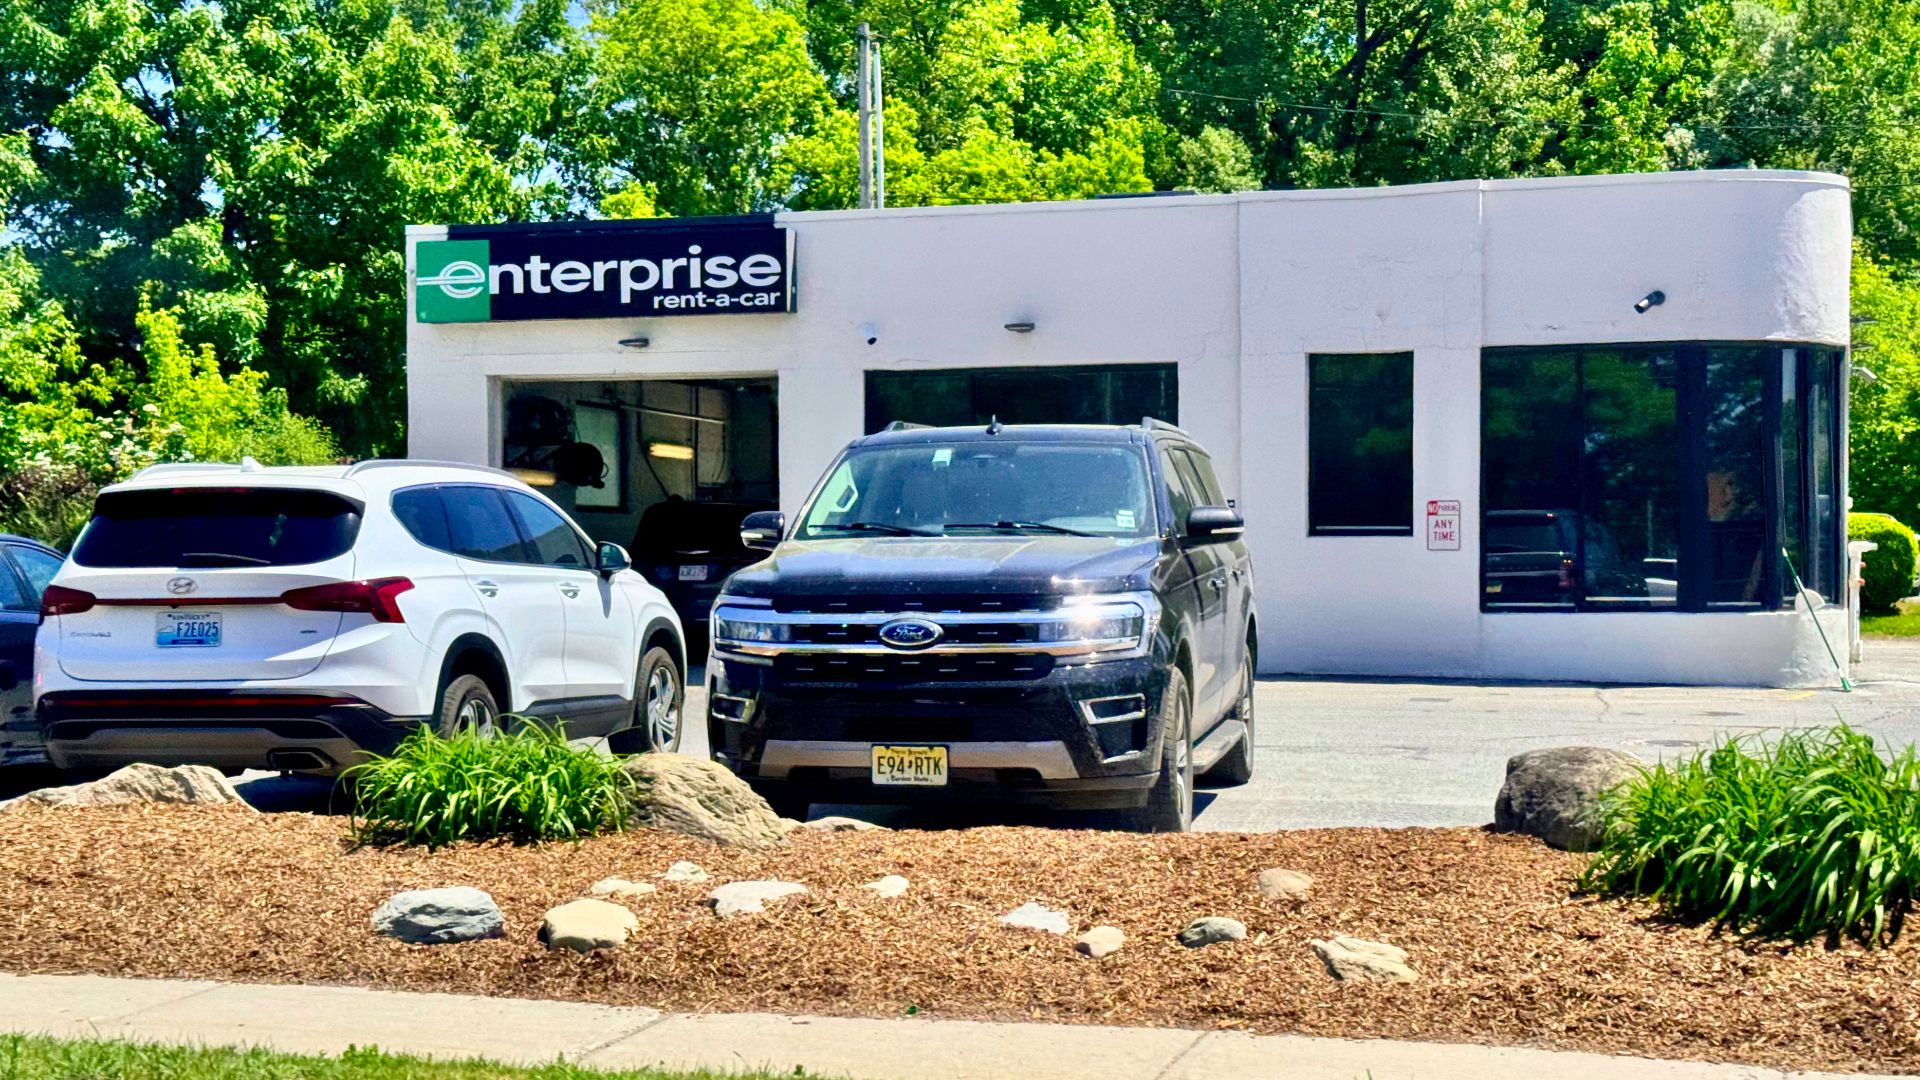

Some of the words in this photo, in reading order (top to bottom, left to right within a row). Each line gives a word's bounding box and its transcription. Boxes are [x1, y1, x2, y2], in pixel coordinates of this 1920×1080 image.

[437, 244, 781, 304] enterprise
[653, 291, 781, 310] rent-a-car
[1428, 503, 1438, 513] NO
[1434, 519, 1453, 529] ANY
[1433, 531, 1455, 541] TIME
[176, 621, 219, 638] F2E025
[893, 624, 924, 640] Ford
